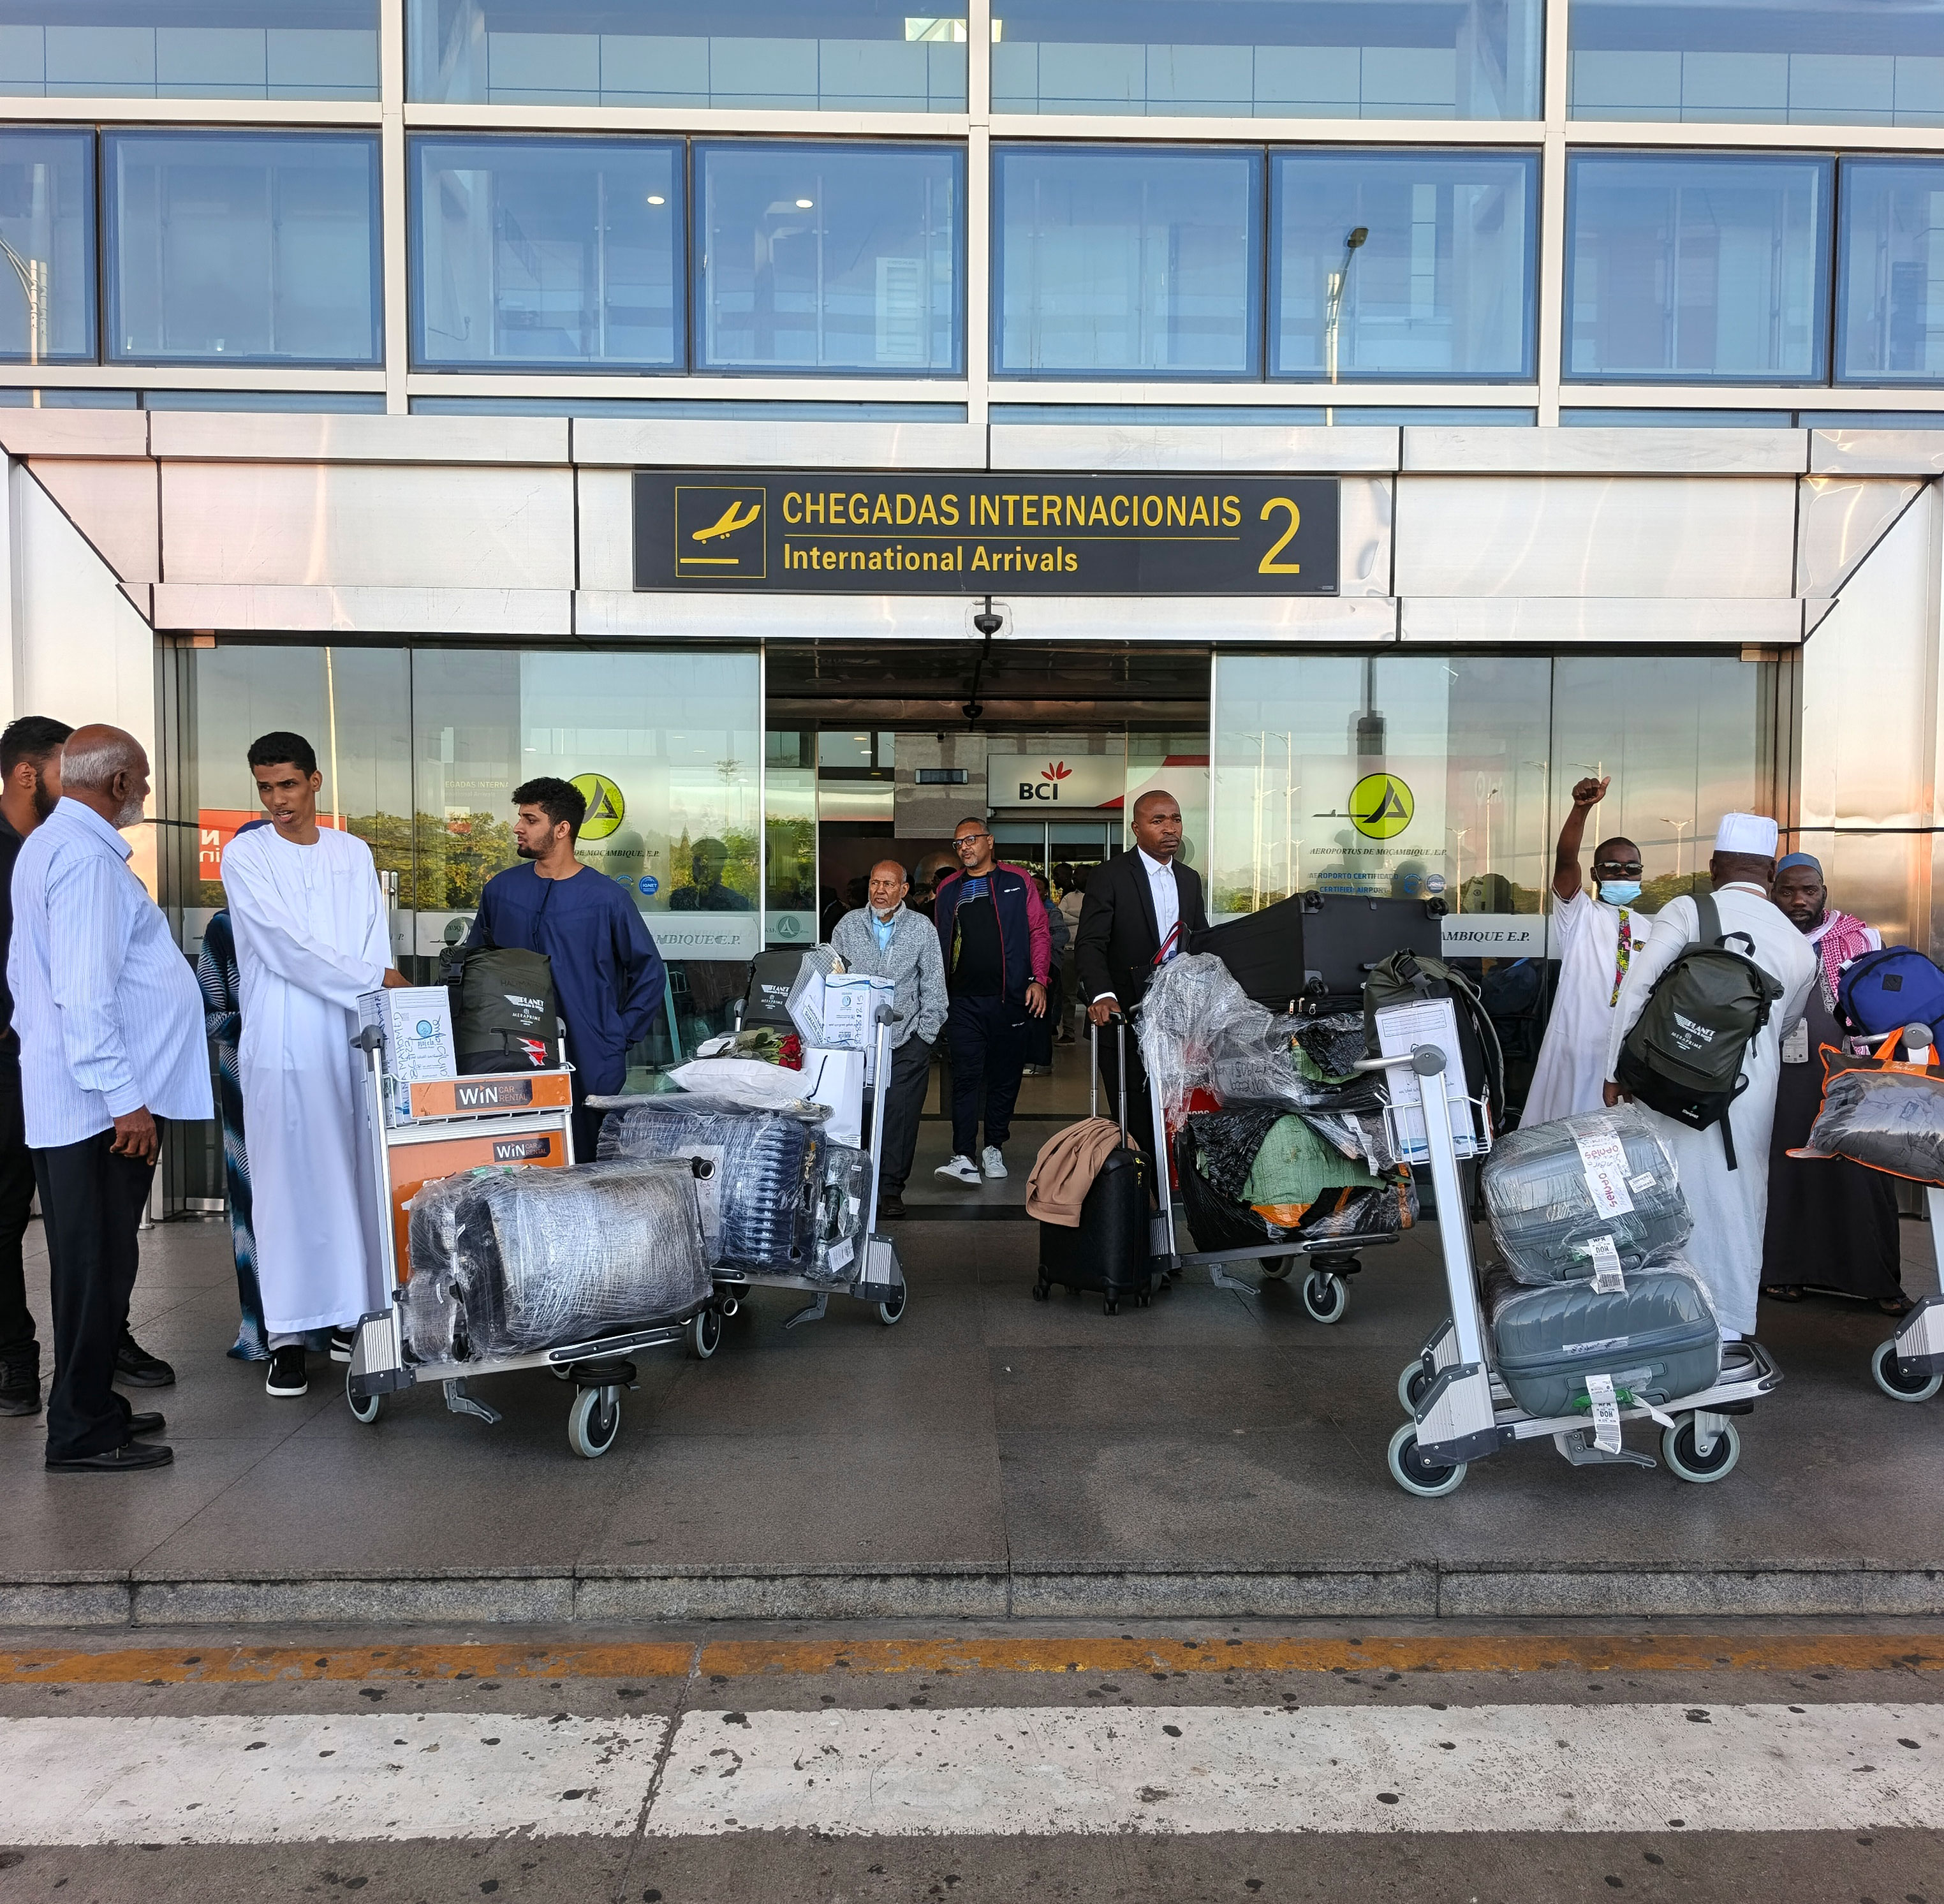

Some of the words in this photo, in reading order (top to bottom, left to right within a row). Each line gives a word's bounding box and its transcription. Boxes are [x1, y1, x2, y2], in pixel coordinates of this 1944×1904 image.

[783, 492, 959, 526] CHEGADAS
[970, 494, 1241, 528] INTERNACIONAIS
[1258, 497, 1300, 574] 2
[784, 543, 962, 572] International
[971, 546, 1078, 572] Arrivals
[1019, 783, 1058, 801] BCI
[1506, 931, 1531, 941] E.P.
[499, 1094, 528, 1102] RENTAL
